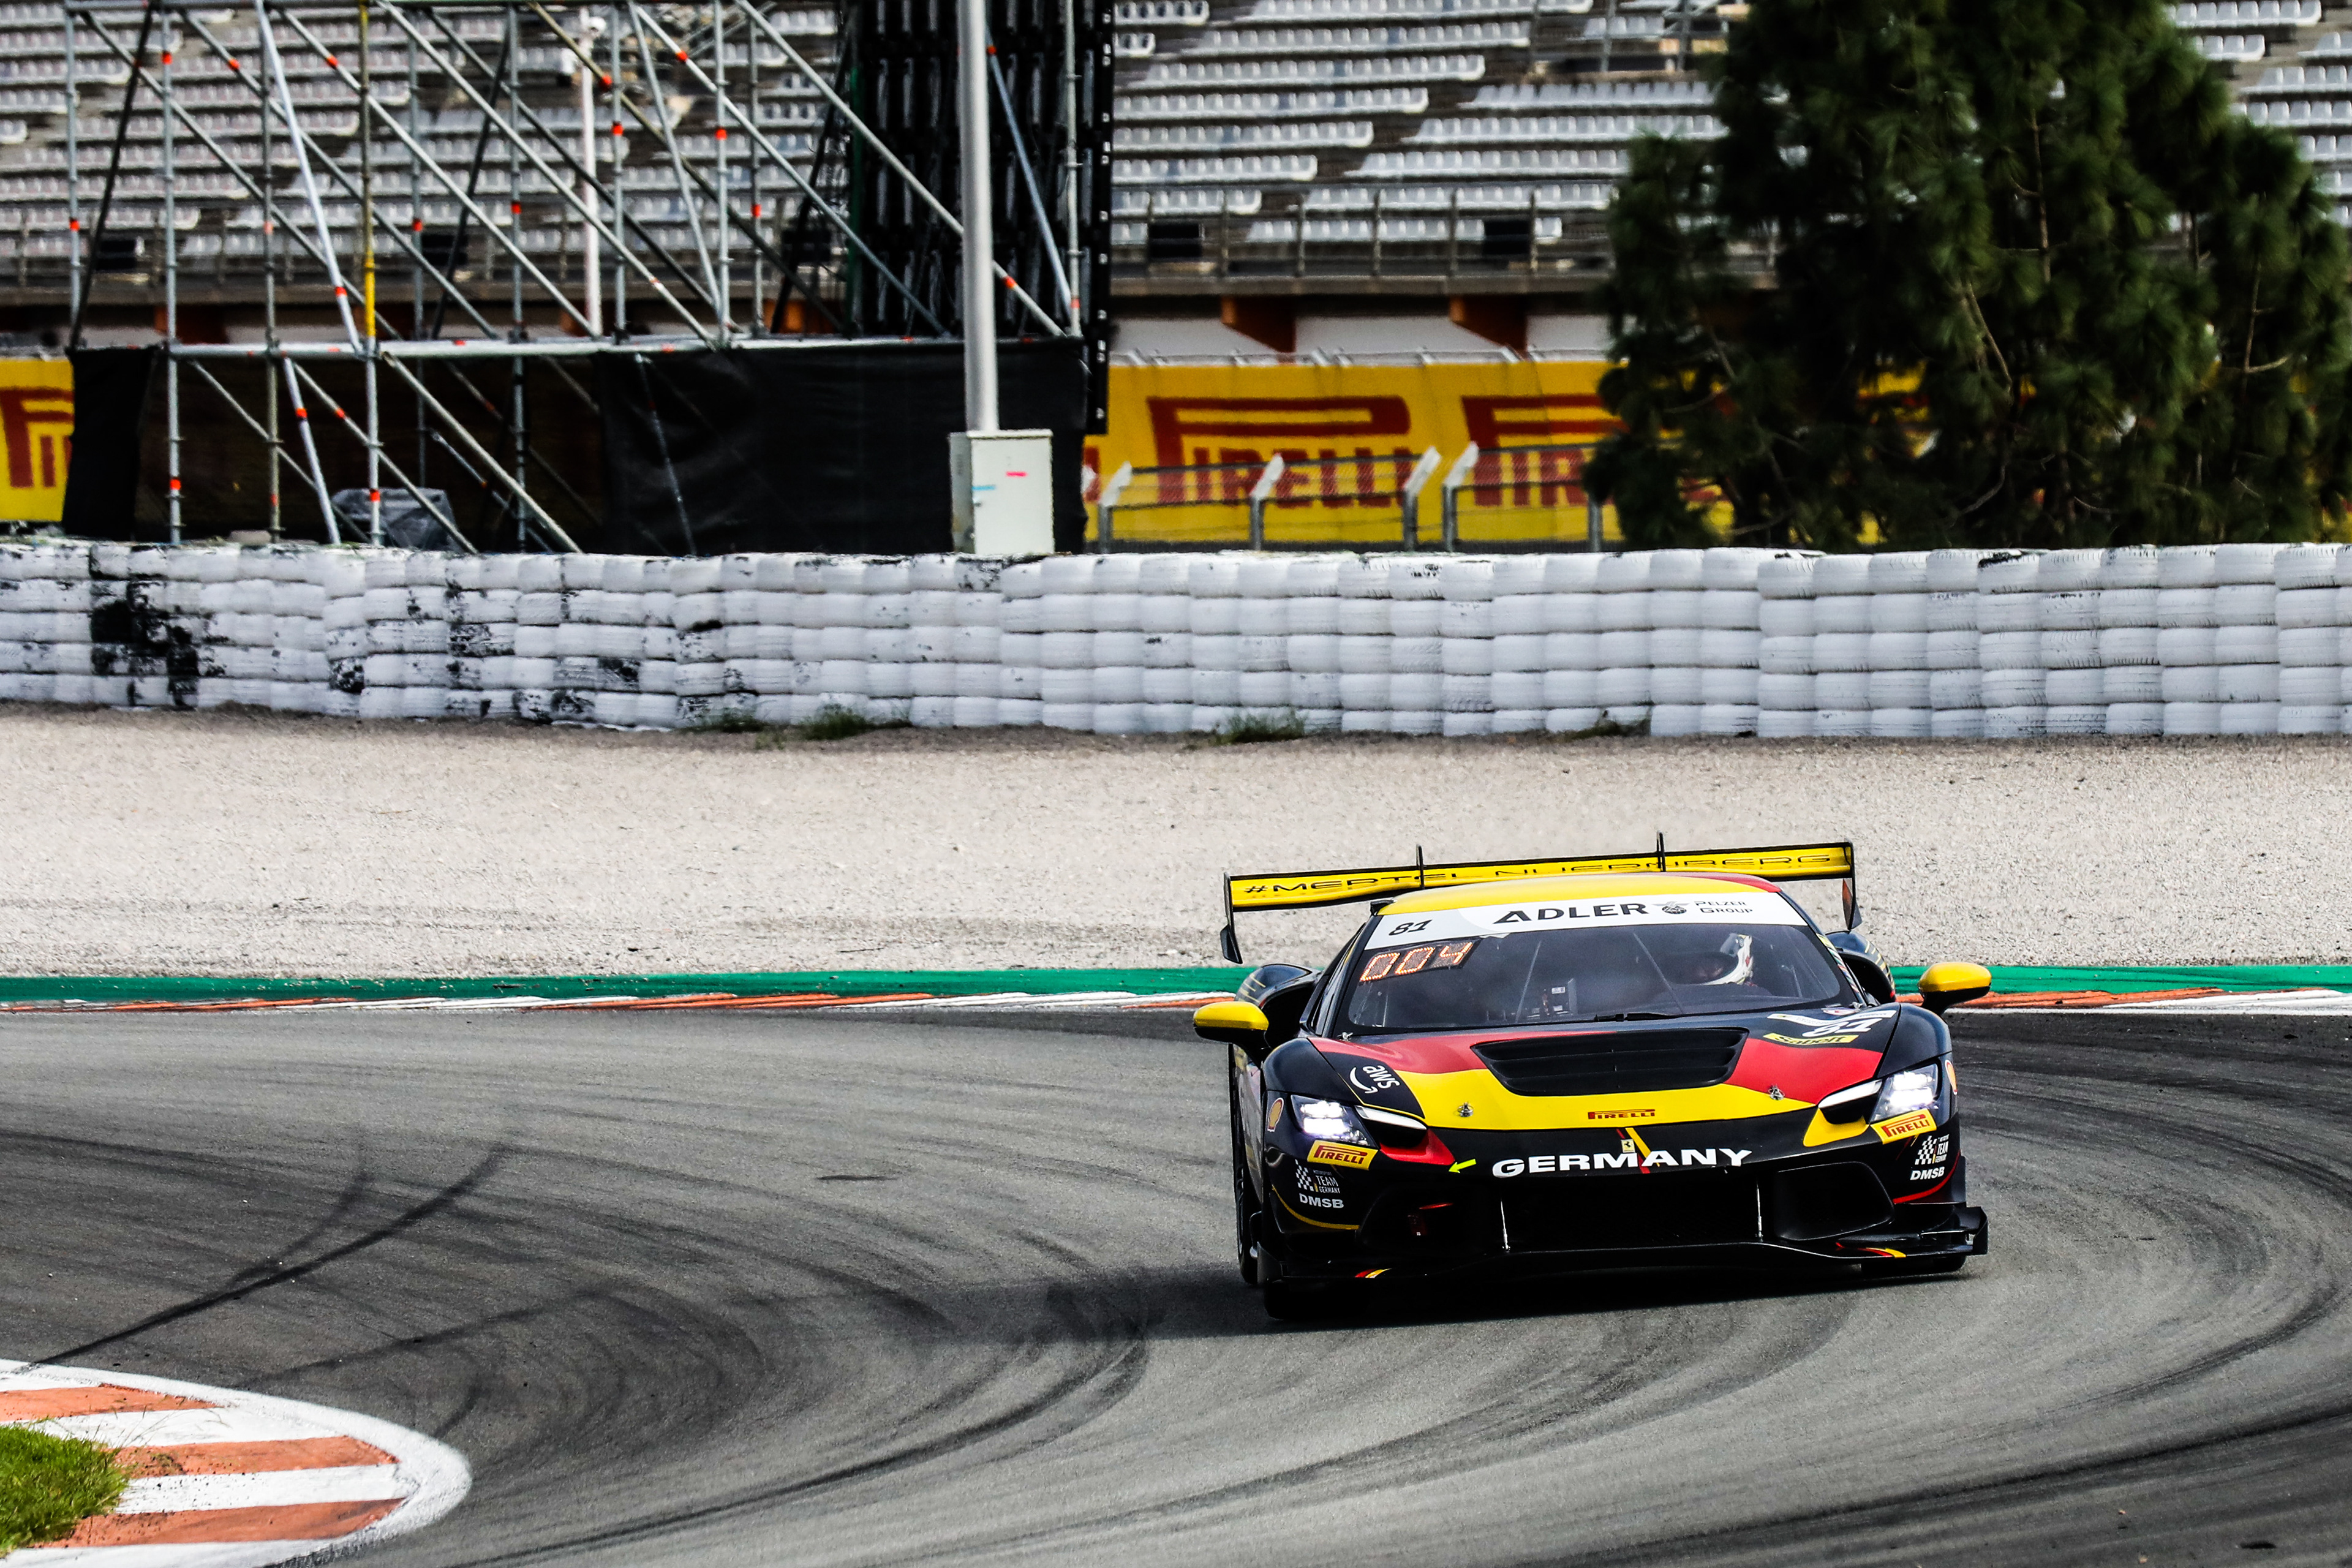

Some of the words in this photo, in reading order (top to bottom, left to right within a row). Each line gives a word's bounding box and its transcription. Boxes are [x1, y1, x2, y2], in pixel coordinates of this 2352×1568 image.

[1147, 395, 1413, 508] PIRELLI
[1493, 903, 1649, 924] ADLER
[1389, 919, 1433, 936] 81
[1360, 941, 1473, 982] 004
[1362, 1065, 1400, 1090] aws
[1588, 1109, 1656, 1120] PIRELLI
[1881, 1114, 1929, 1137] PIRELLI
[1314, 1145, 1368, 1164] PIRELLI
[1492, 1148, 1752, 1178] GERMANY
[1316, 1175, 1339, 1186] TEAM
[1910, 1166, 1945, 1180] DMSB
[1299, 1193, 1344, 1208] DMSB
